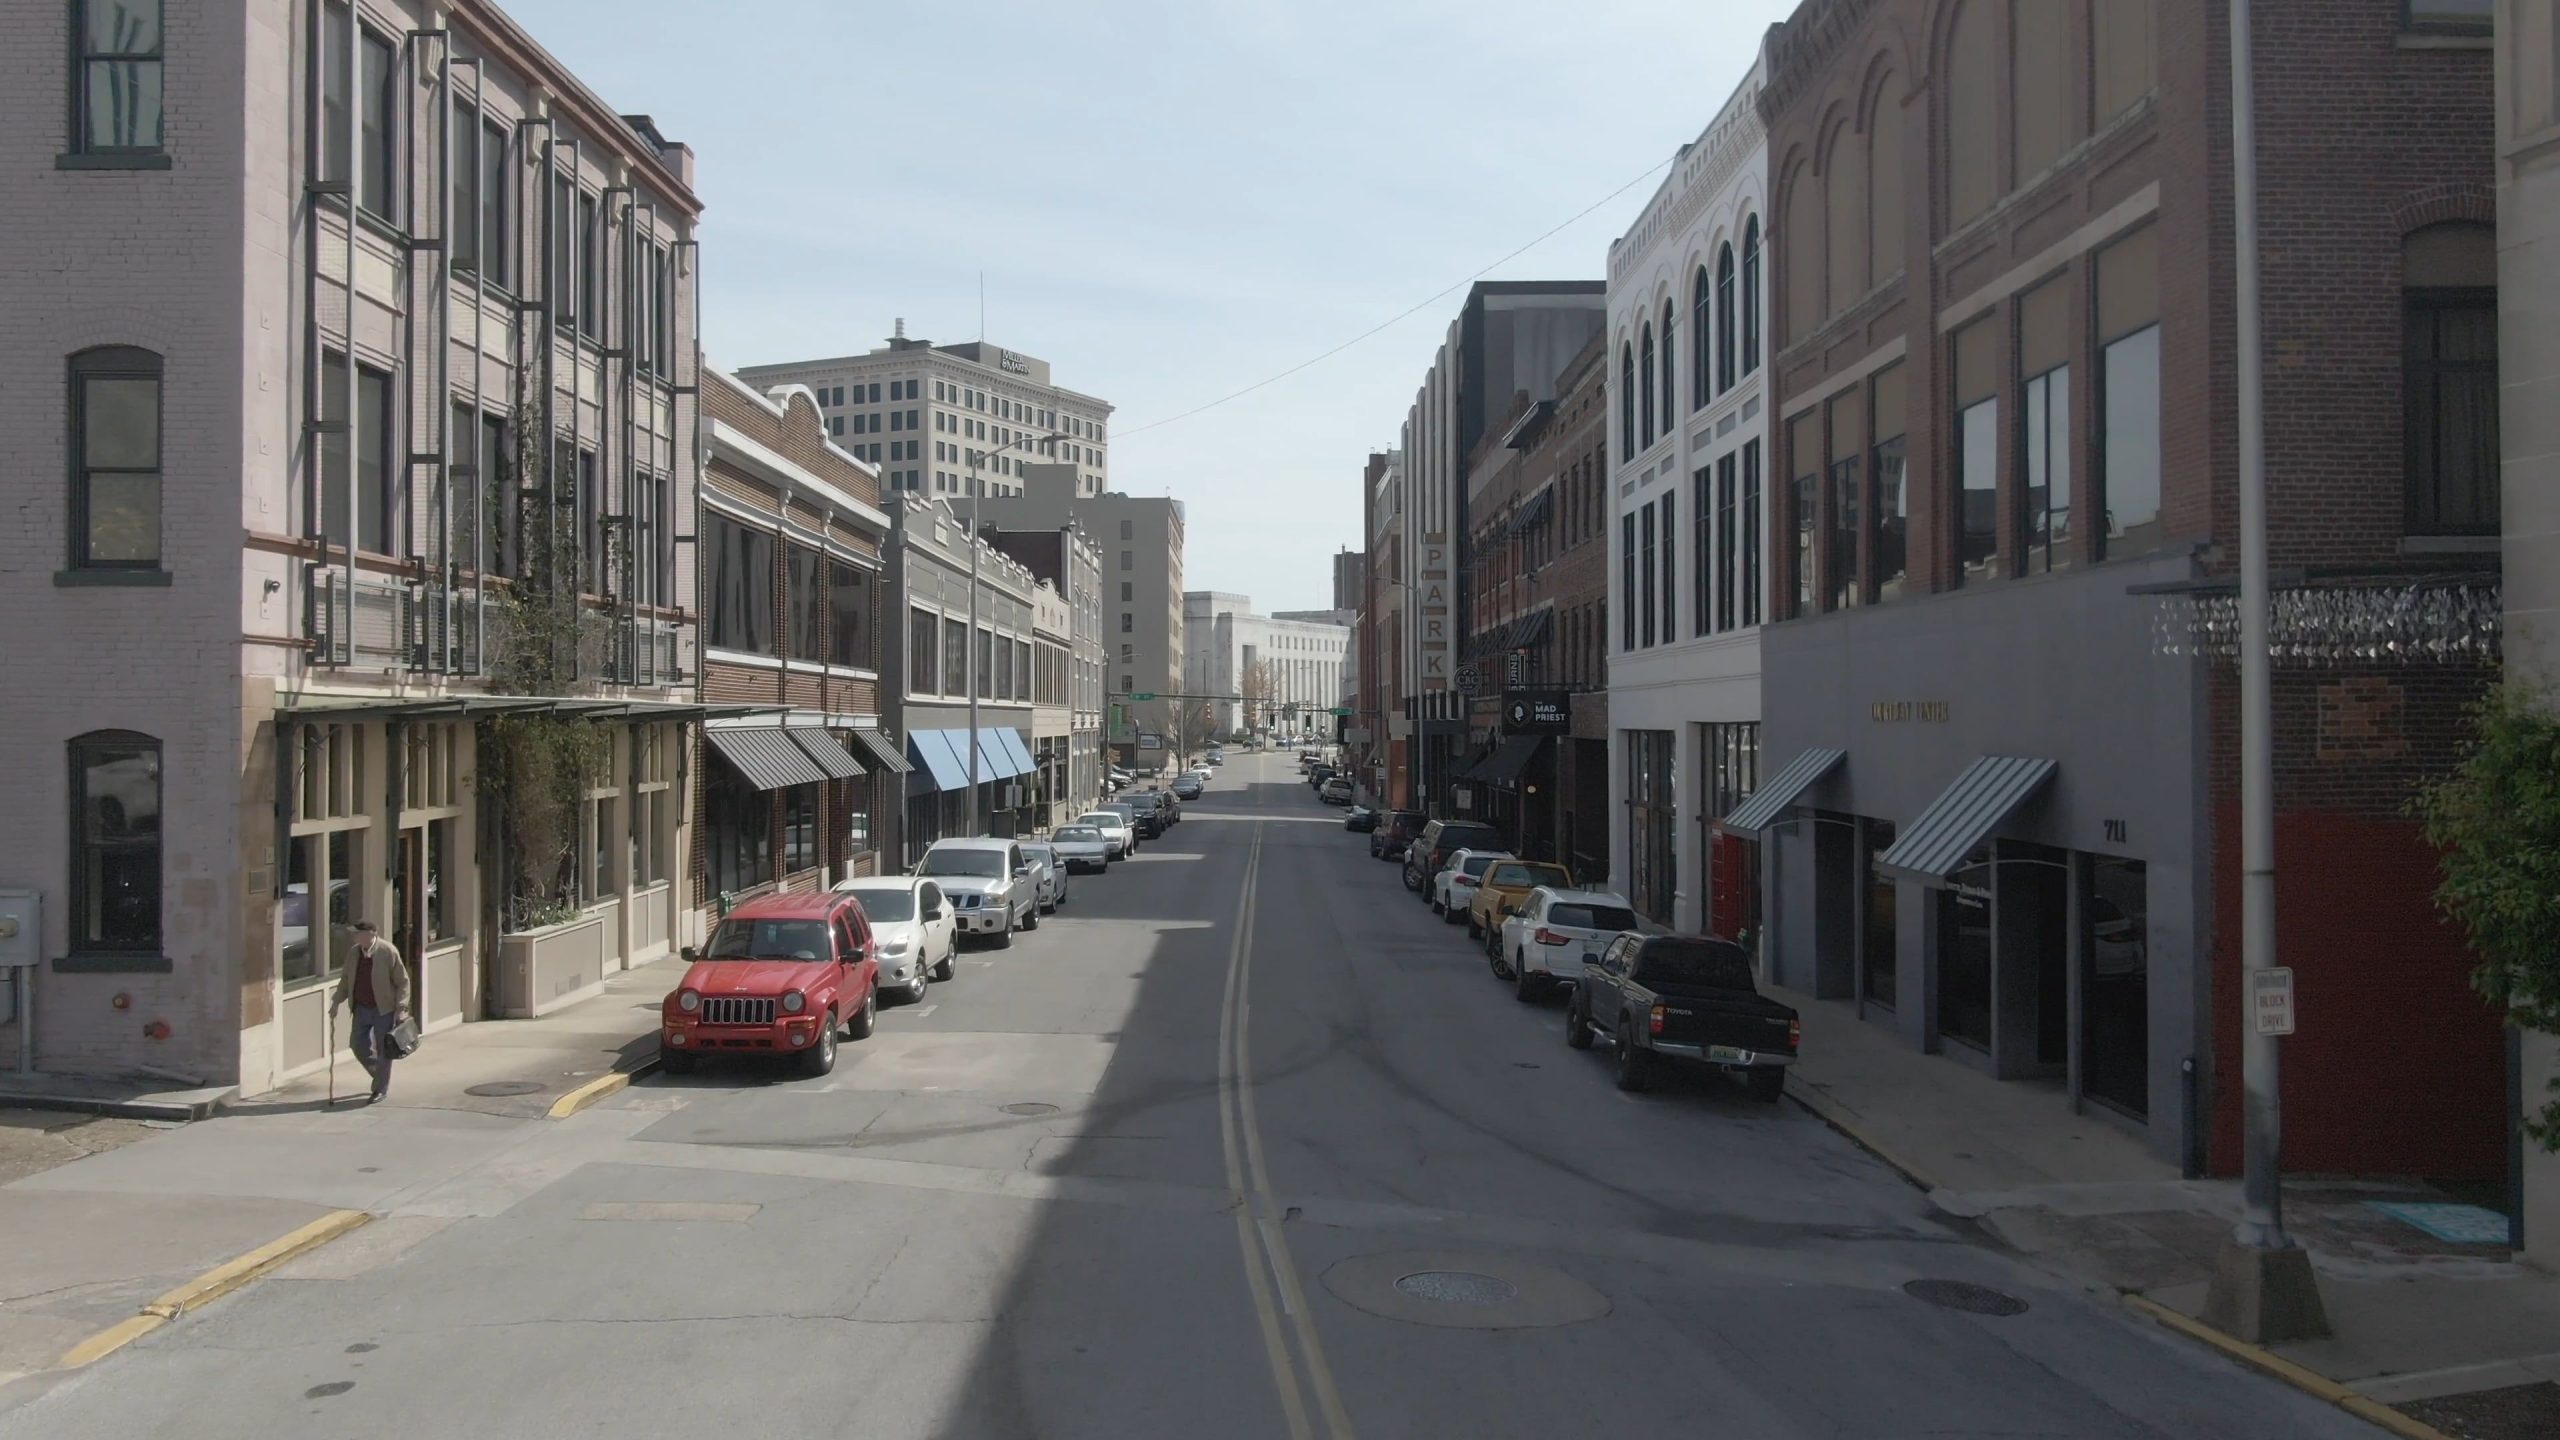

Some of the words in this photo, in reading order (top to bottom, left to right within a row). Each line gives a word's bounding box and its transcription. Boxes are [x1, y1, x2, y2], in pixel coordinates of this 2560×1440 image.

[1428, 549, 1442, 673] PARK
[1535, 705, 1557, 713] MAD
[1535, 713, 1566, 721] PRIEST
[2104, 819, 2127, 844] 711
[2260, 995, 2286, 1008] BLOCK
[1666, 1008, 1693, 1016] TOYOTA
